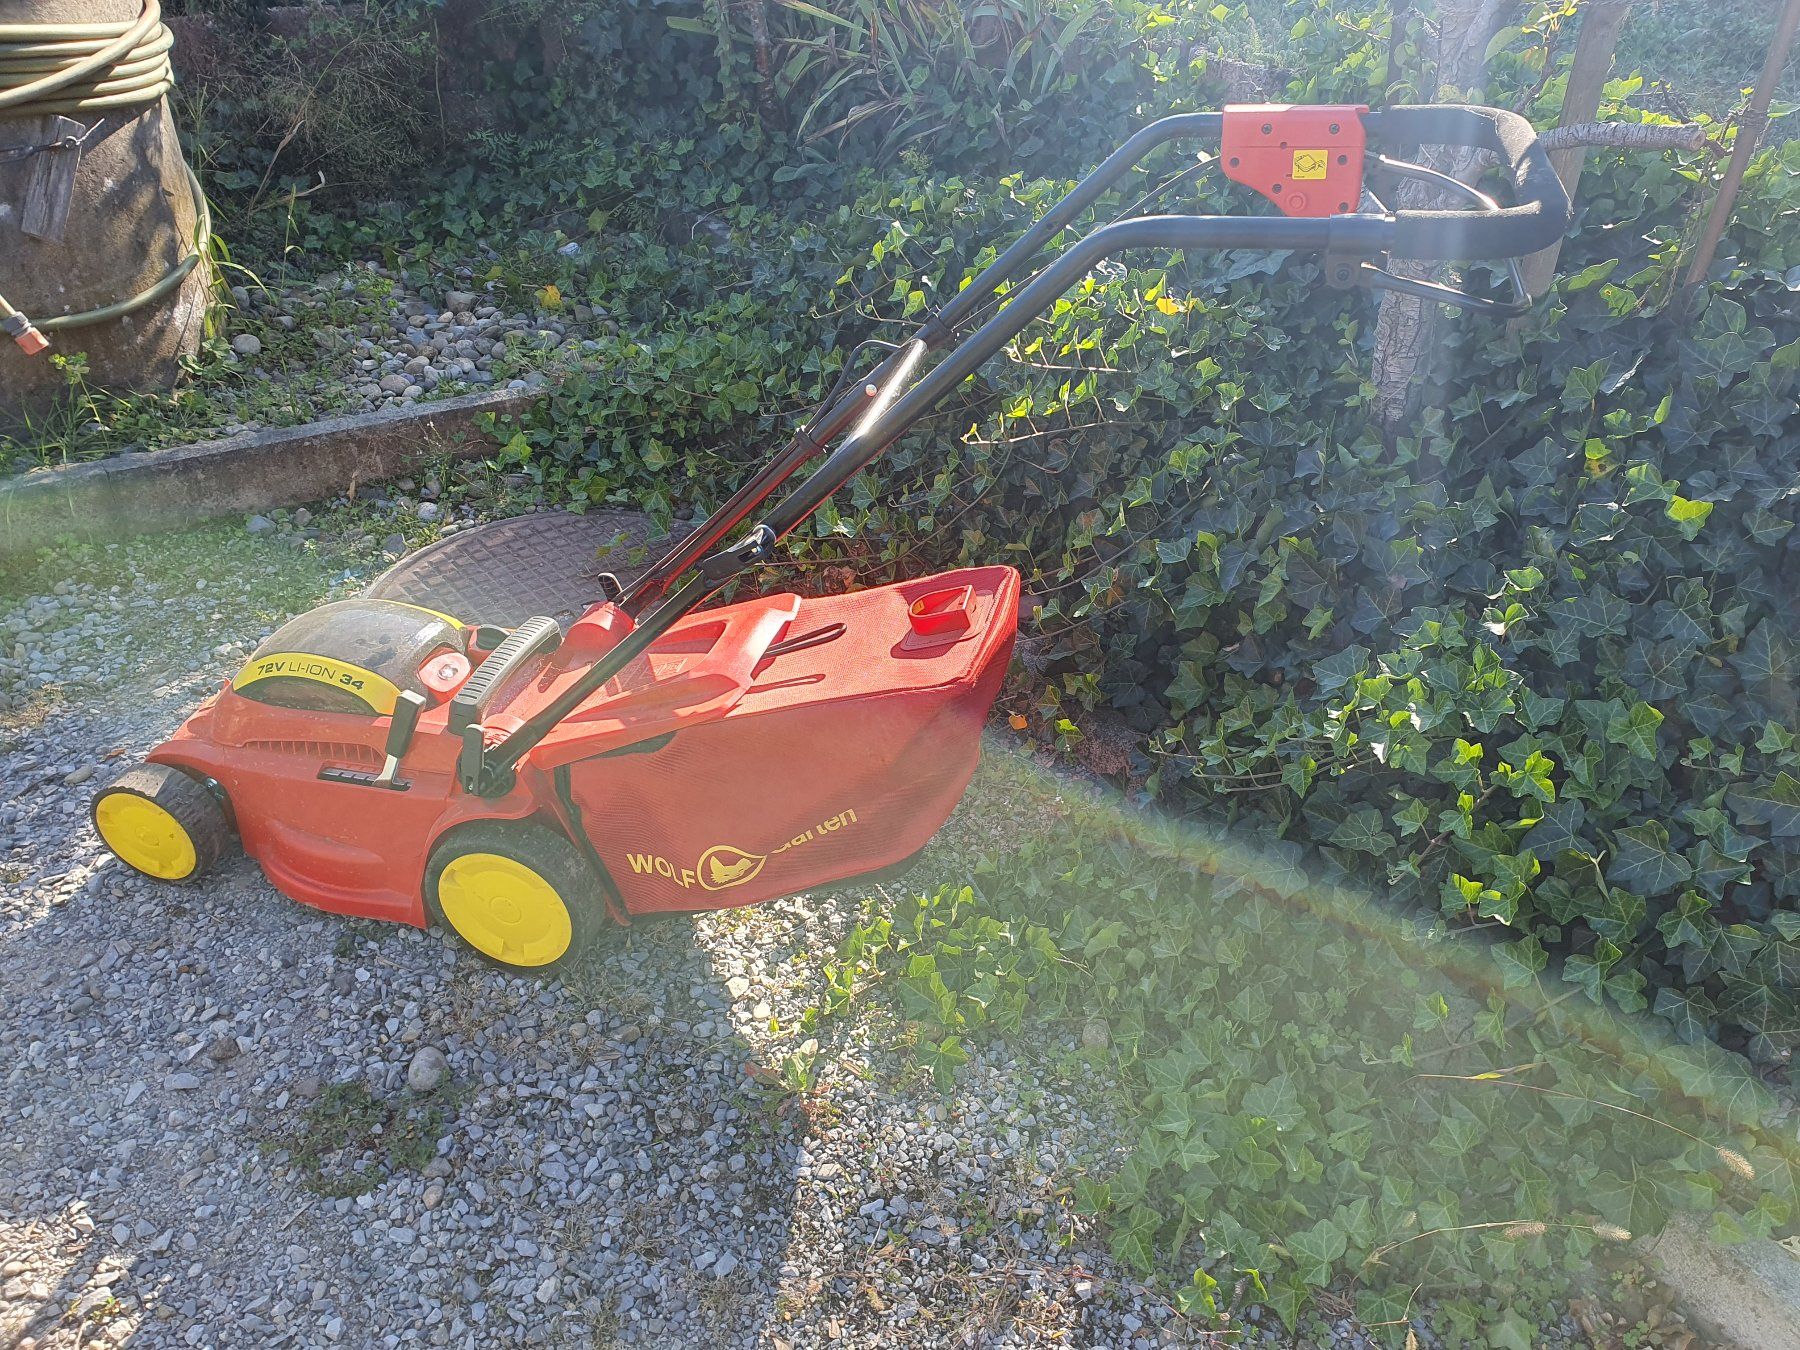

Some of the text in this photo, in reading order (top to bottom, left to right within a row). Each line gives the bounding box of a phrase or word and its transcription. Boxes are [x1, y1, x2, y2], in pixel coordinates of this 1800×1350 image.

[257, 661, 365, 691] 72V LI-ION 34
[626, 808, 858, 889] WOLF arten
